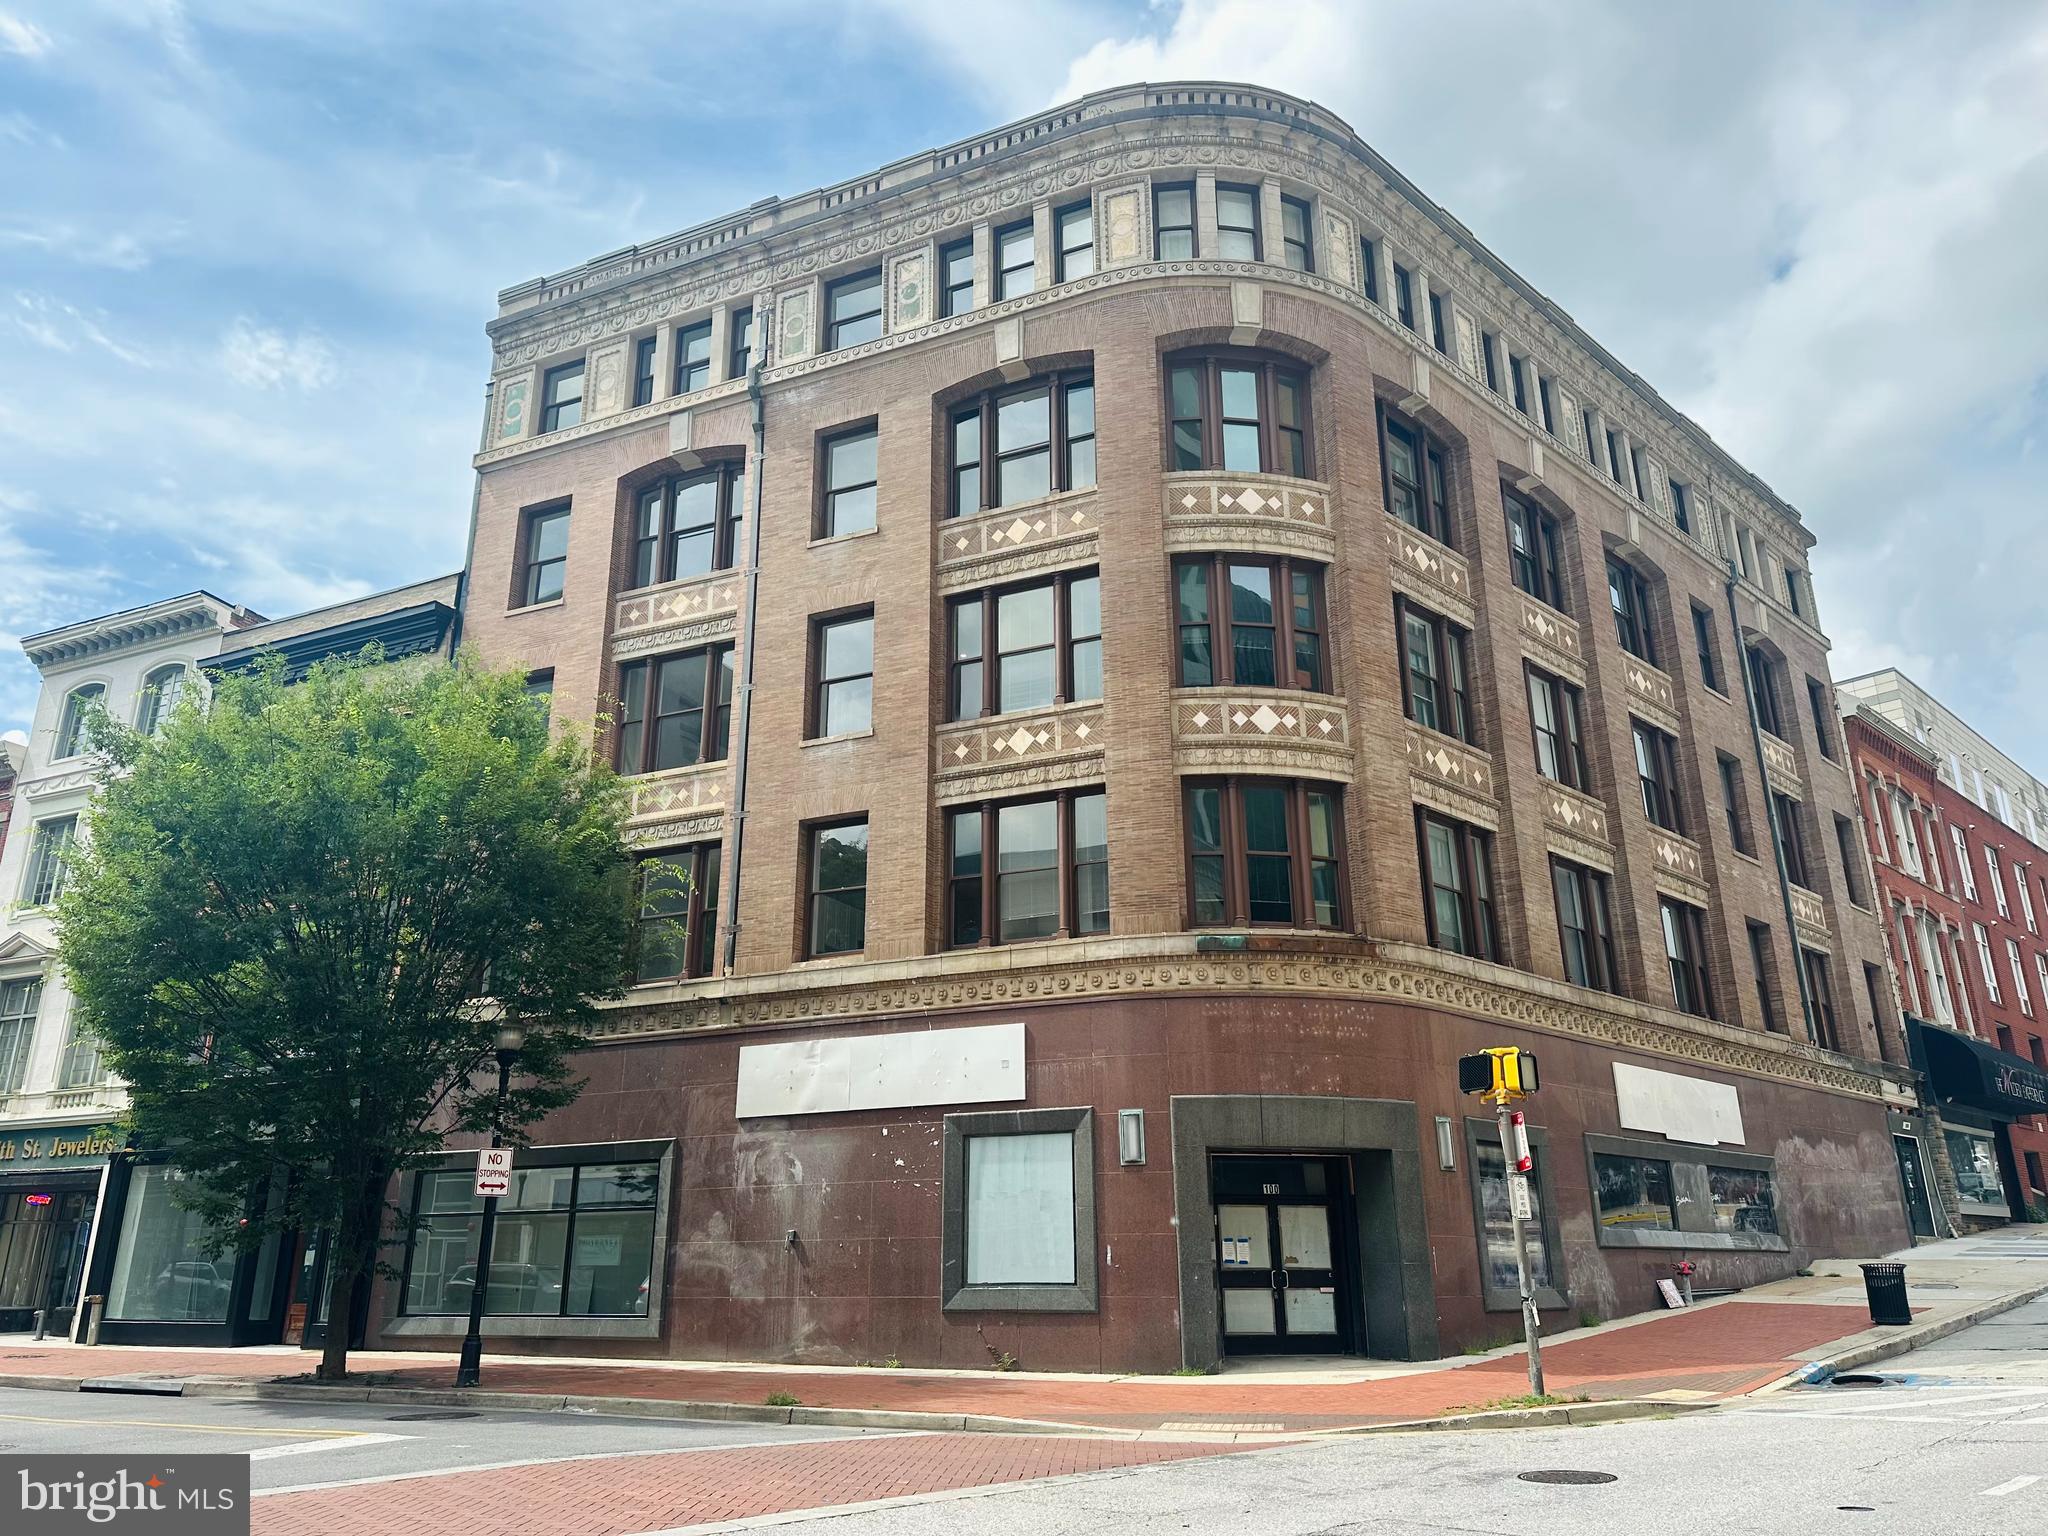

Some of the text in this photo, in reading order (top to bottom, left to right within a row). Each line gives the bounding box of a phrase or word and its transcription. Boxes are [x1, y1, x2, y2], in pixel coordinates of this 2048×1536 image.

[22, 1138, 42, 1159] St.
[48, 1136, 115, 1157] Jewelers
[487, 1153, 503, 1165] NO
[479, 1169, 508, 1178] STOPPING
[1263, 1184, 1279, 1194] 100
[26, 1195, 51, 1204] OPEN
